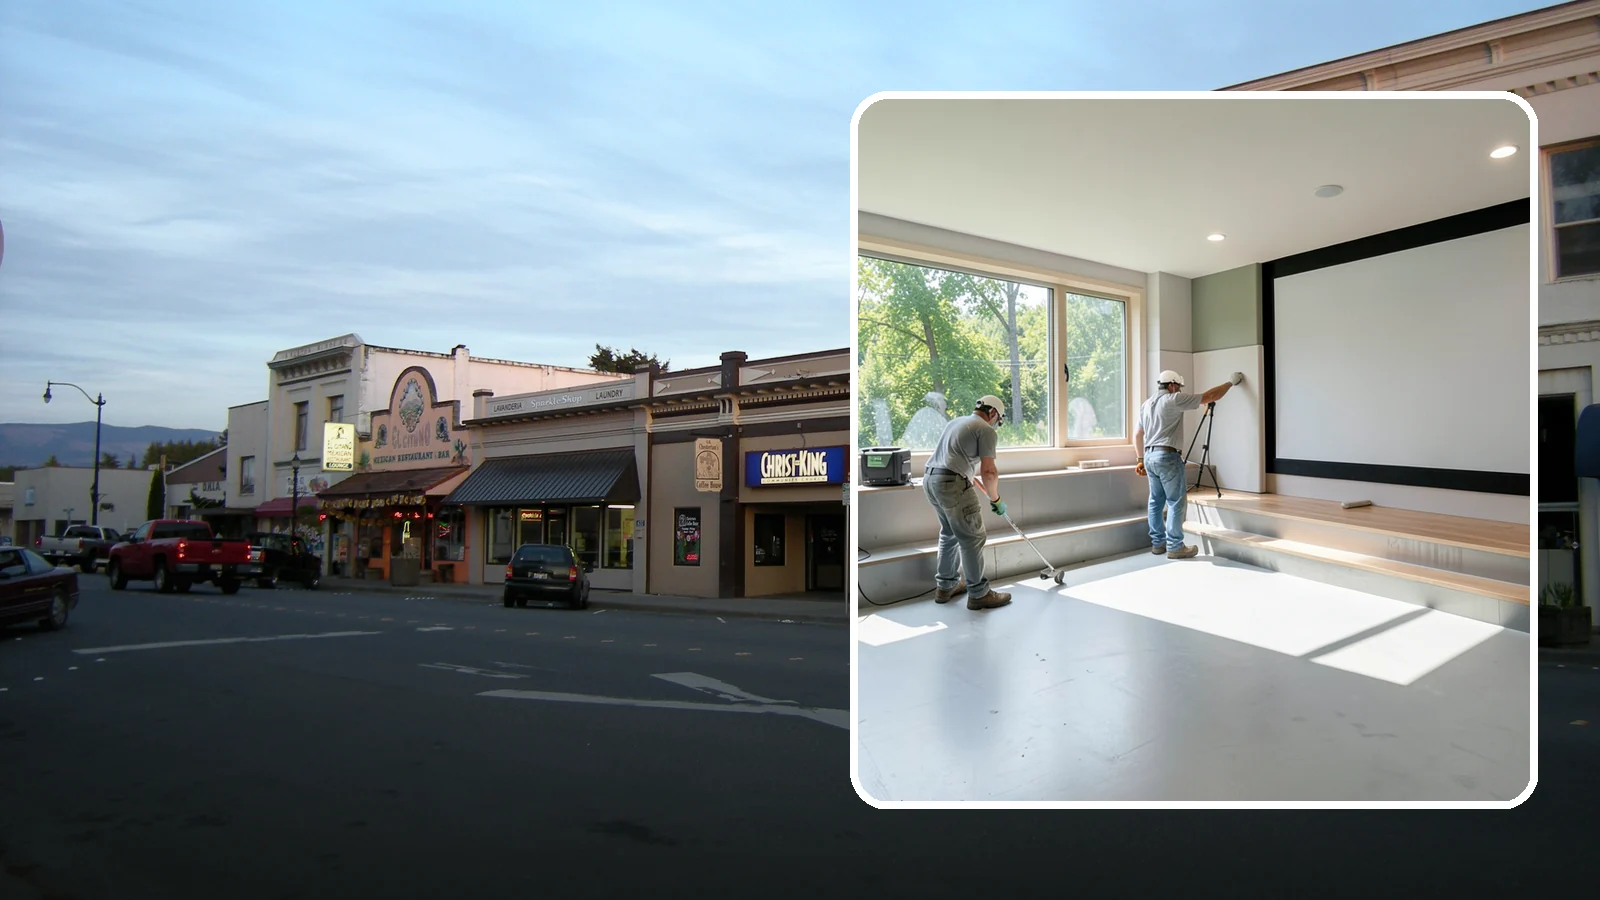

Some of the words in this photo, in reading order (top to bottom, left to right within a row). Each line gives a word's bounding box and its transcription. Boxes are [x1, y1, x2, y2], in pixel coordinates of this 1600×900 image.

[595, 389, 623, 399] LAUNDRY
[493, 402, 522, 412] LAVANDERIA
[373, 455, 396, 463] MEXICAN
[397, 451, 433, 462] RESTAURANT
[437, 450, 450, 459] BAR
[760, 452, 798, 478] CHRIST
[799, 450, 828, 476] KING
